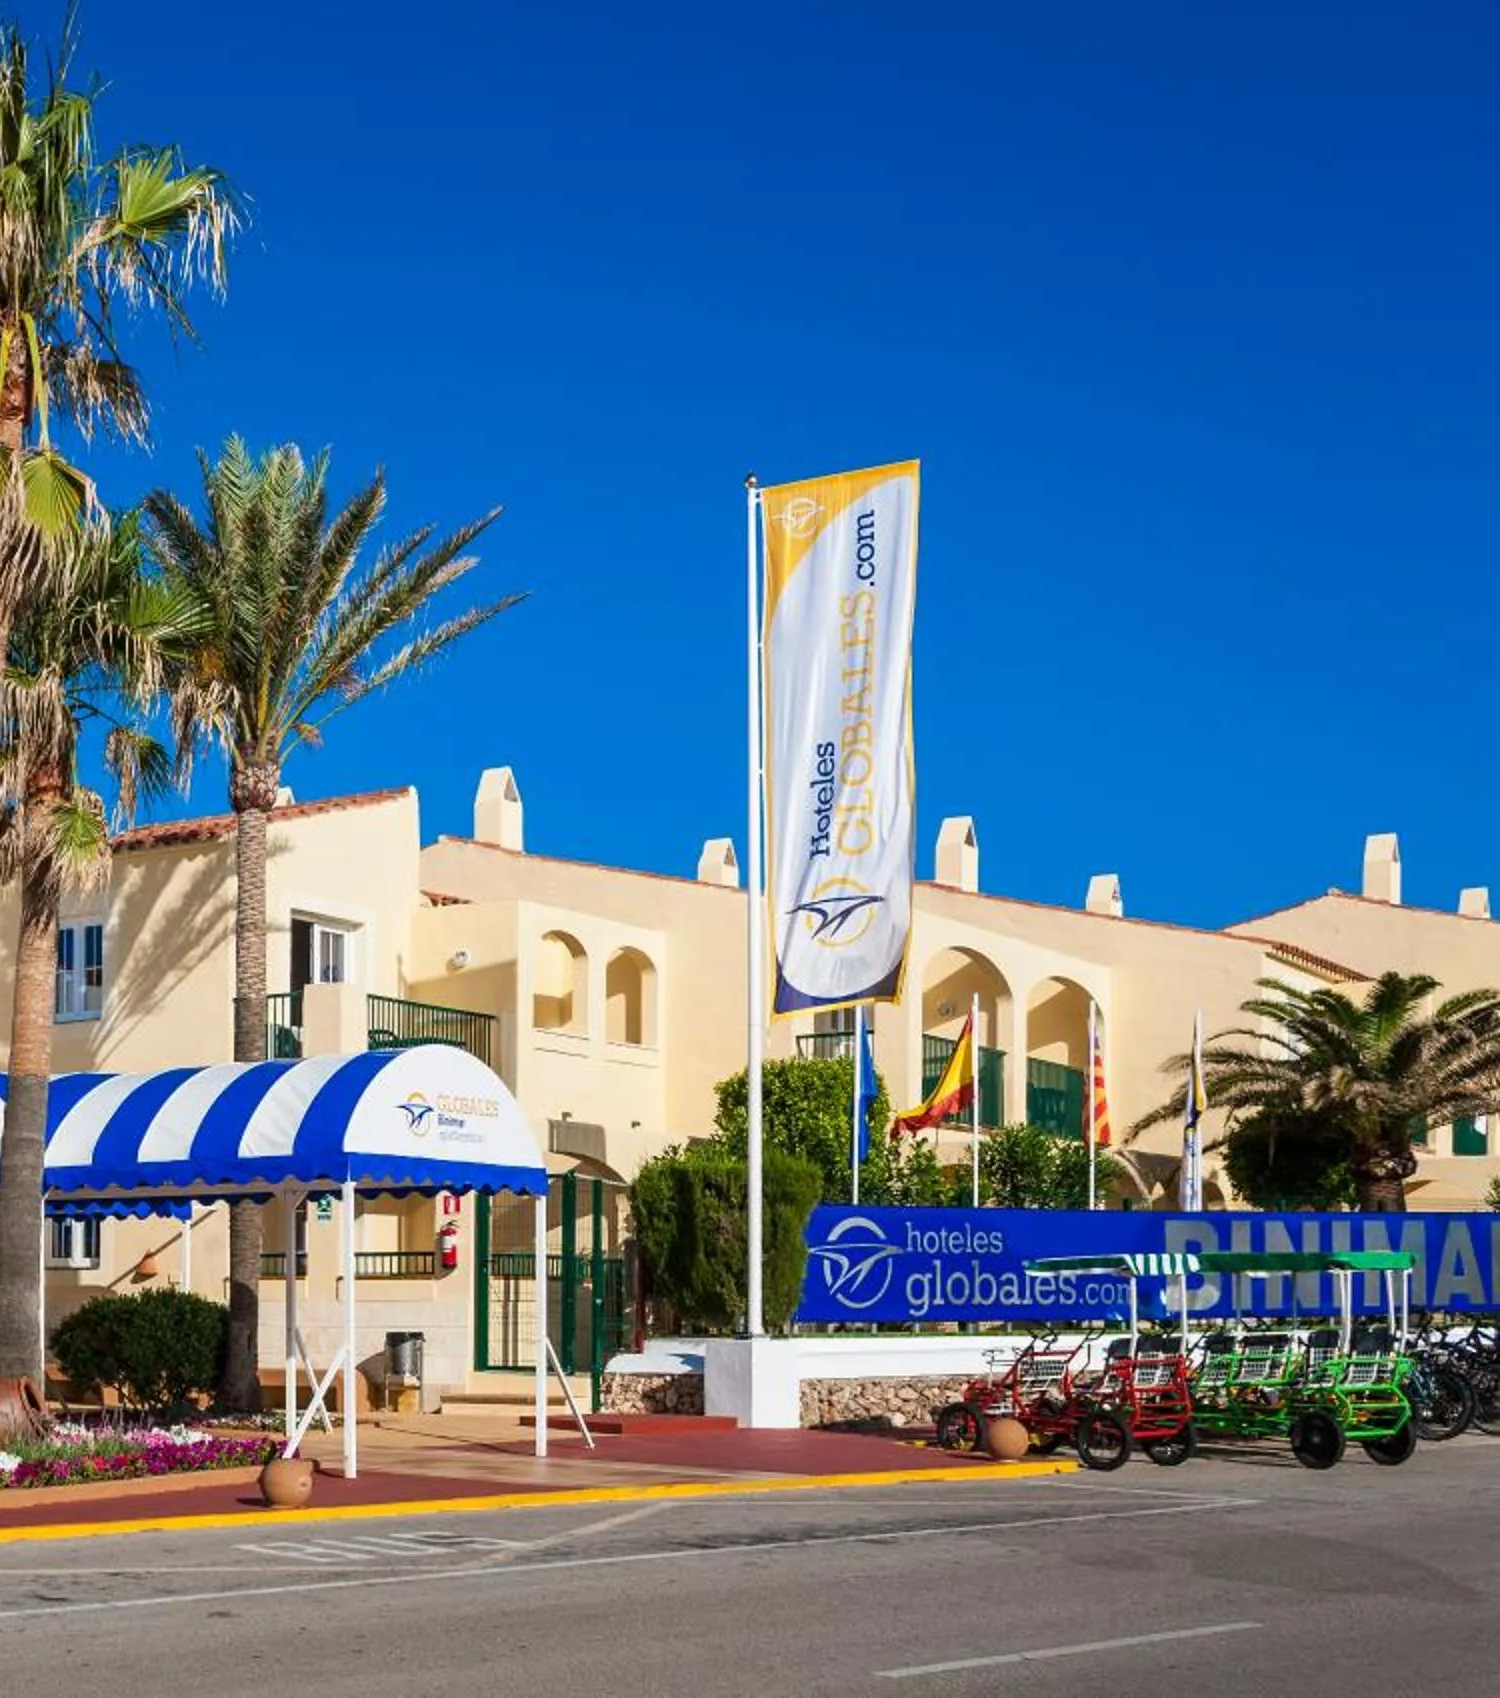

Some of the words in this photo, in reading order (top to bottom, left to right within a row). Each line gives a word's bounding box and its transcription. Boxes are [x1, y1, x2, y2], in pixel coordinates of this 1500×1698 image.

[810, 741, 836, 860] Hoteles
[905, 1221, 1003, 1253] hoteles
[1164, 1219, 1500, 1311] BINIMA
[233, 1531, 507, 1562] BUS
